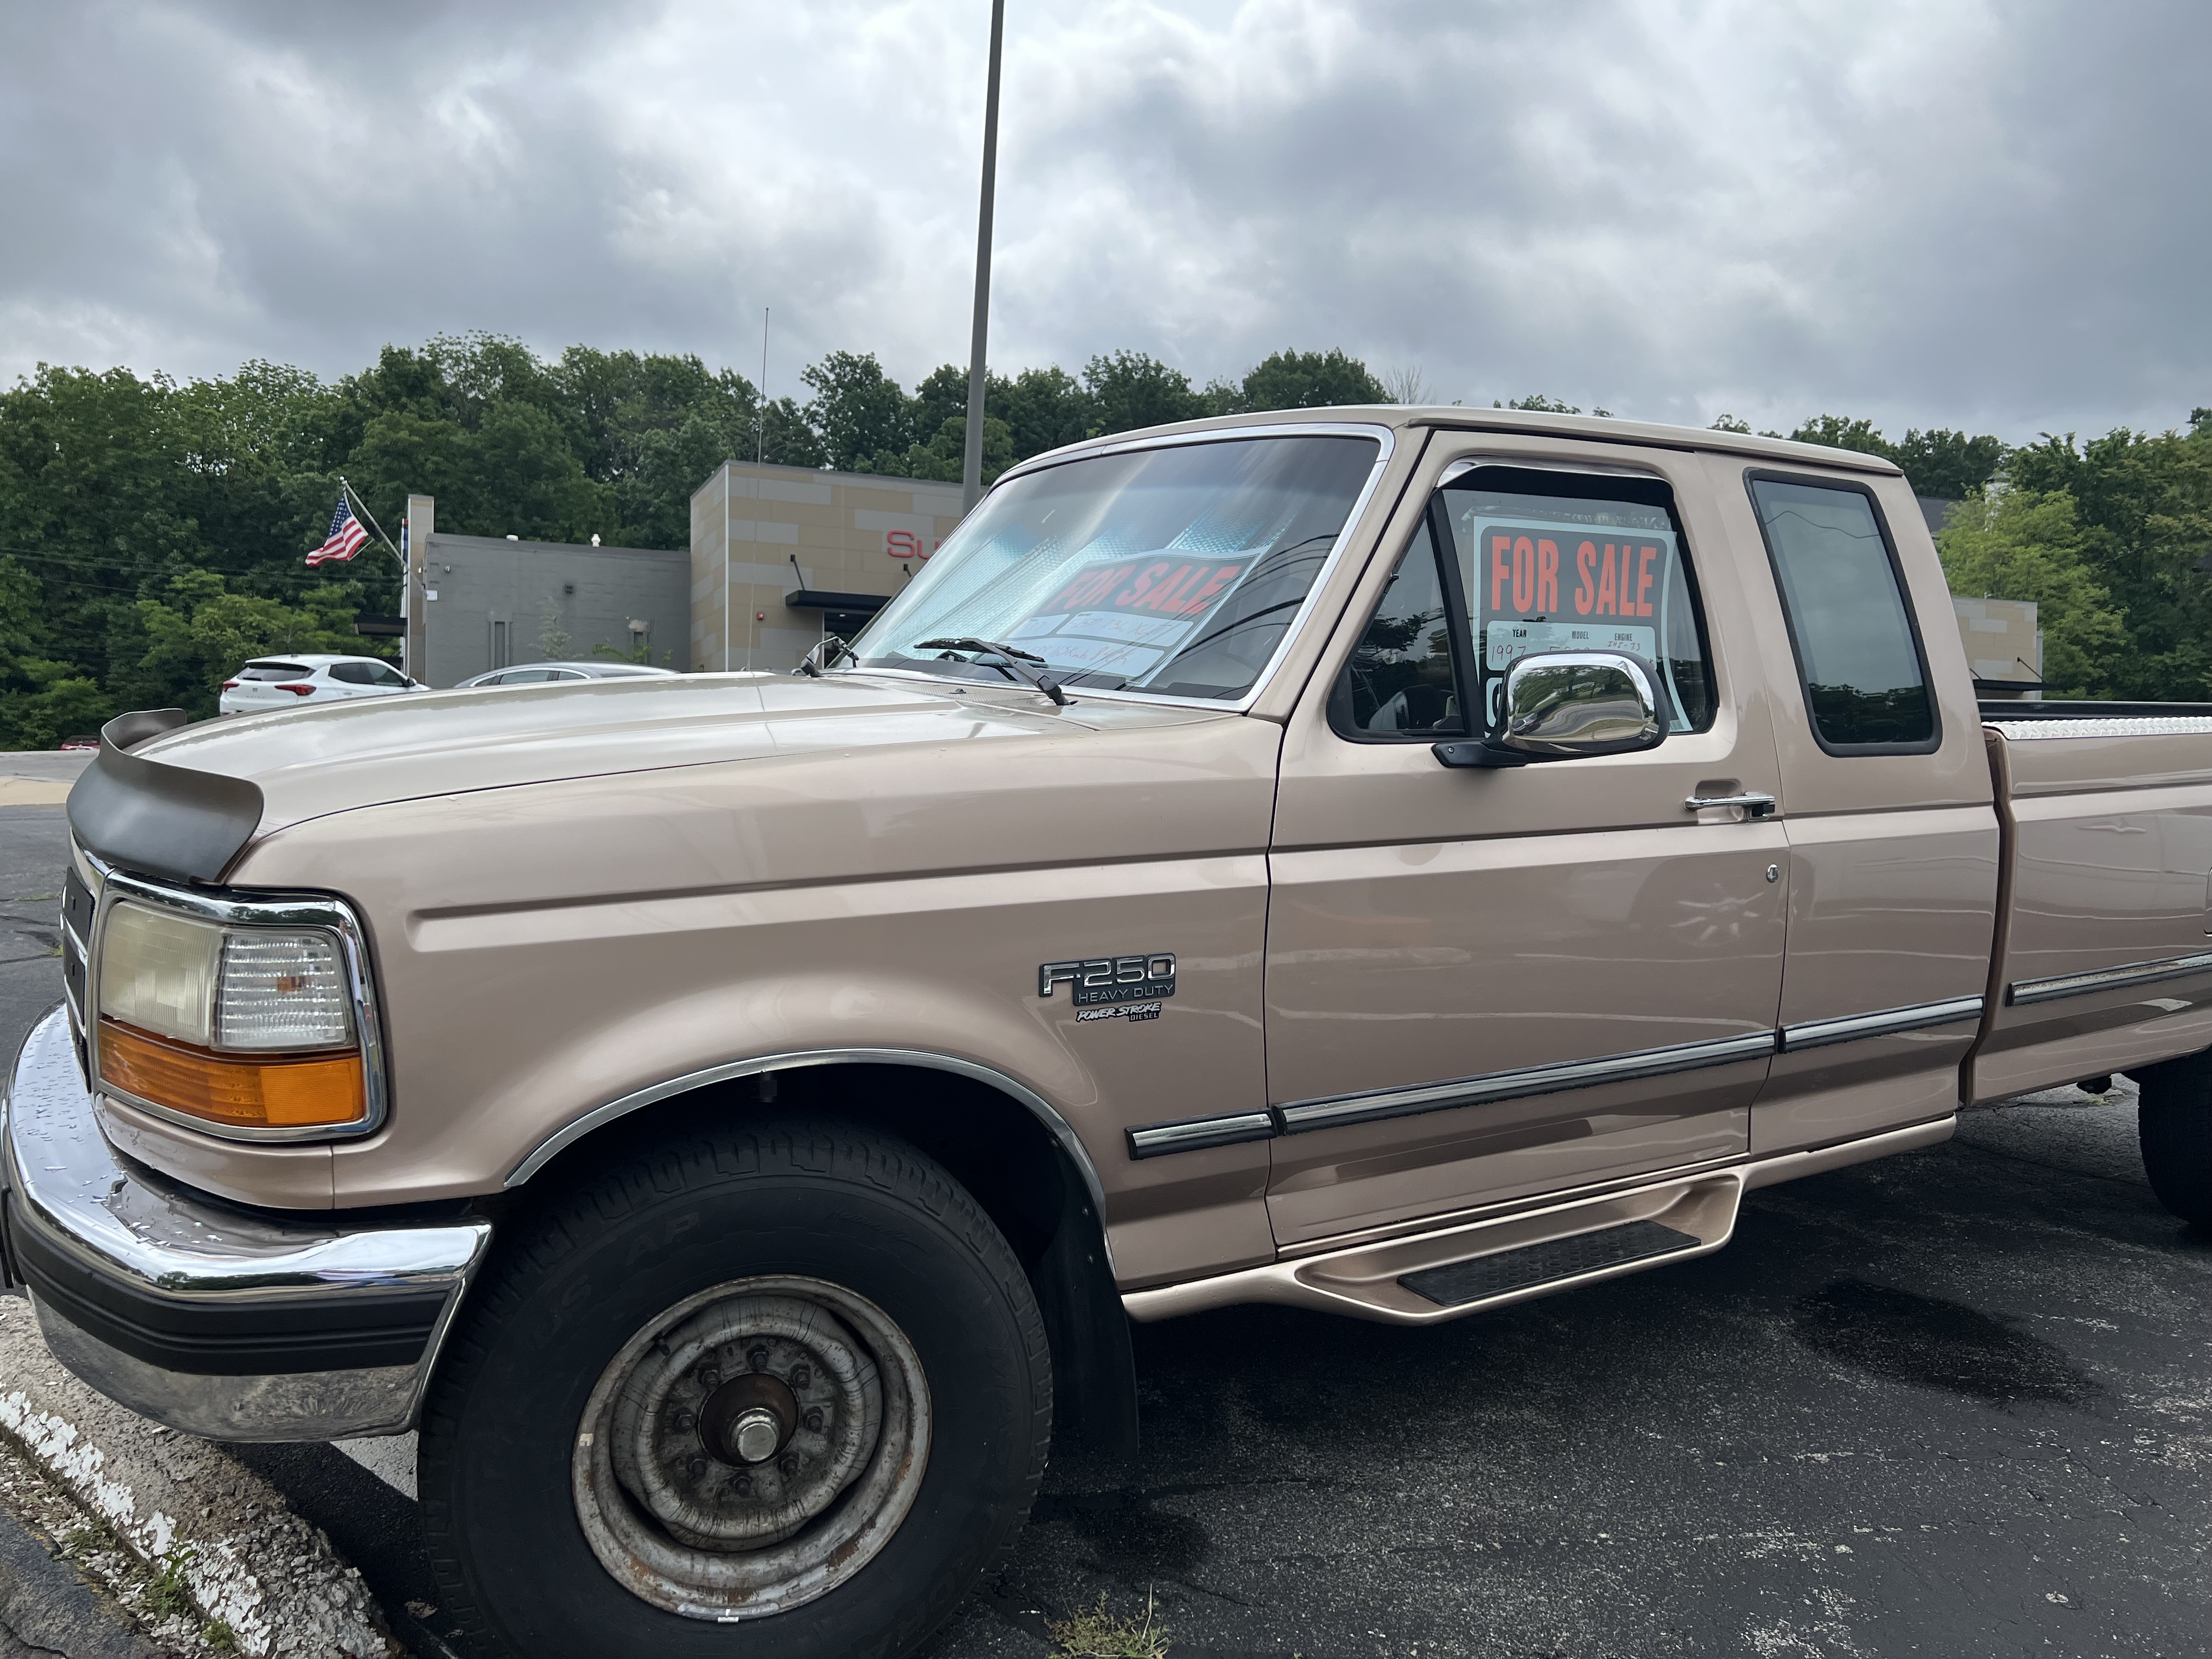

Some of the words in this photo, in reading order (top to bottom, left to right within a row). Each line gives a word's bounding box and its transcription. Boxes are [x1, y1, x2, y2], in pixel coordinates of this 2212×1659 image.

[1491, 536, 1559, 613] FOR
[1574, 540, 1657, 617] SALE
[1042, 565, 1136, 611] FOR
[1115, 562, 1243, 614] SALE
[1513, 629, 1527, 637] YEAR
[1572, 631, 1589, 639] MODEL
[1614, 633, 1633, 641] ENGINE
[1491, 644, 1527, 662] 1997
[1079, 989, 1128, 1003] HEAVY
[1133, 984, 1173, 997] DUTY
[1077, 1007, 1116, 1022] POWER
[1116, 1002, 1161, 1016] STROKE
[1130, 1012, 1158, 1021] DIESEL
